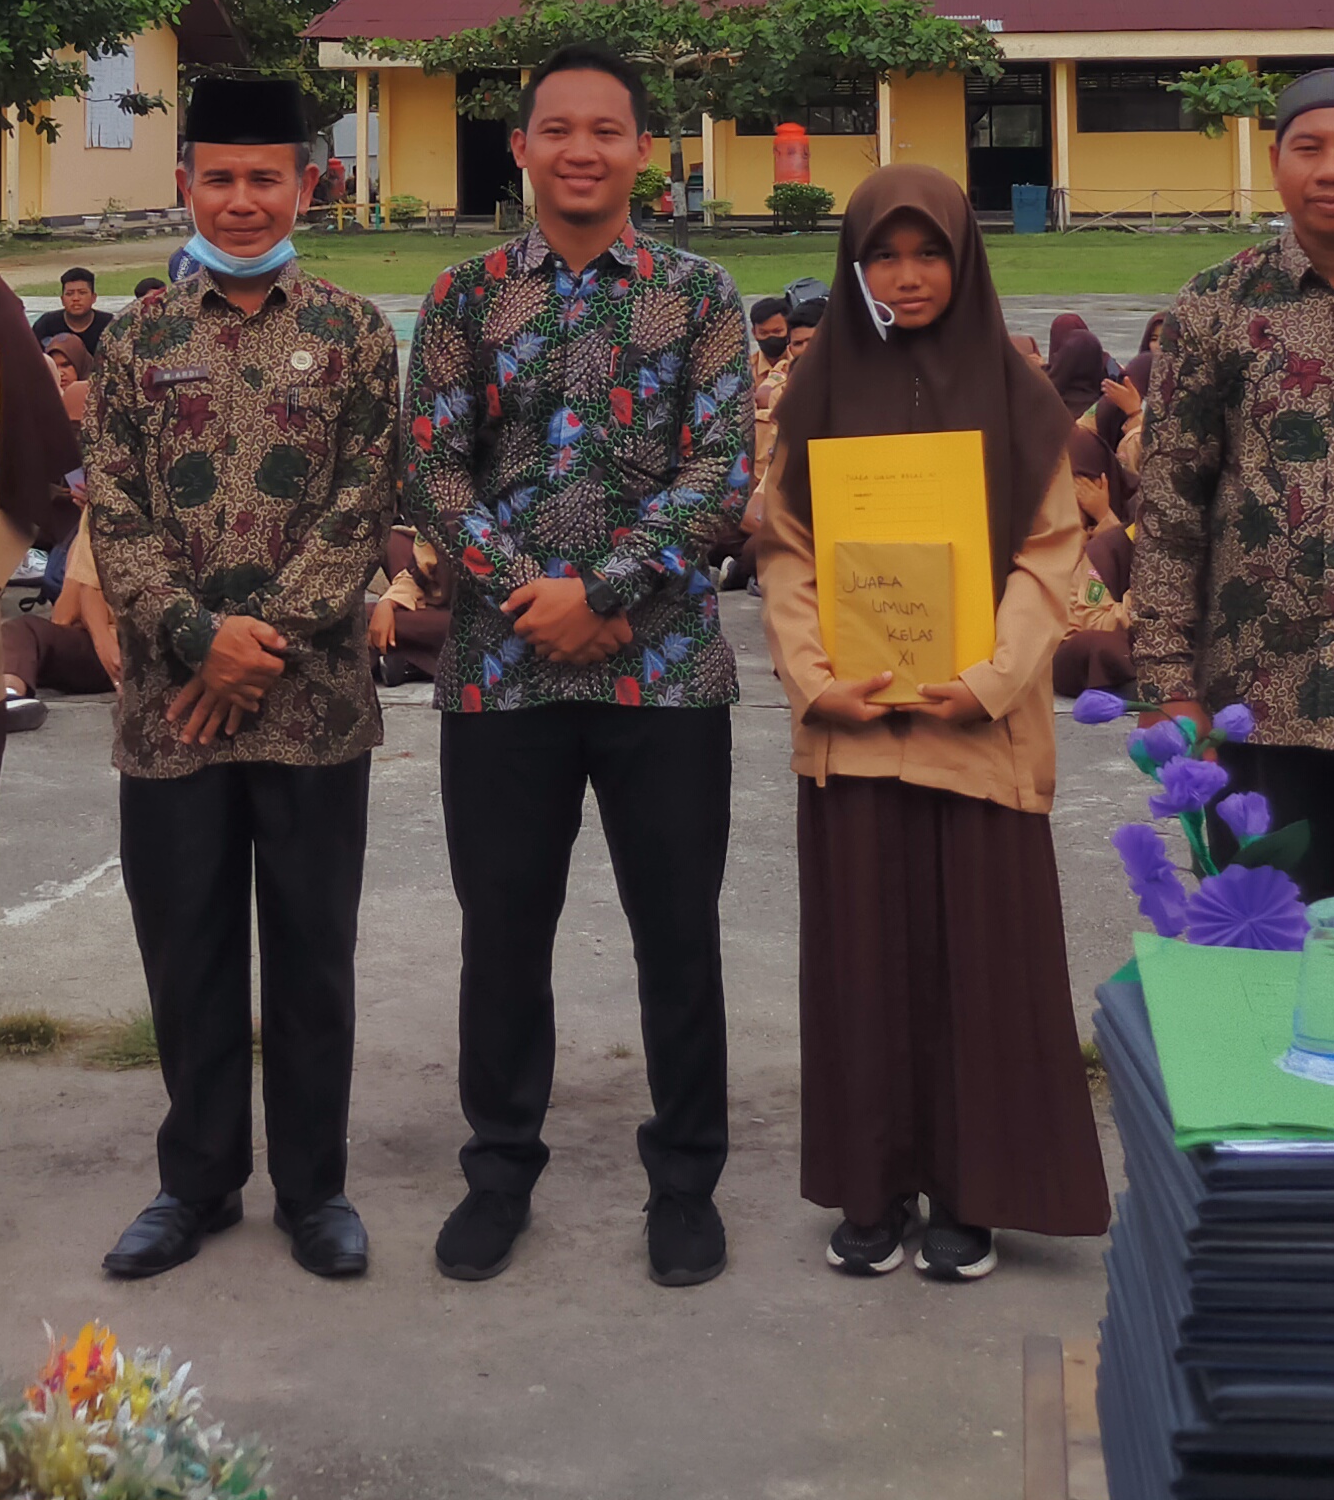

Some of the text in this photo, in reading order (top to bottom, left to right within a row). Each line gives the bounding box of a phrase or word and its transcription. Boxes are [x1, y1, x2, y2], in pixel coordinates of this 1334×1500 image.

[842, 571, 903, 594] JUARA
[871, 599, 929, 618] UMUM
[885, 624, 934, 643] KELAS
[897, 649, 916, 668] XI
